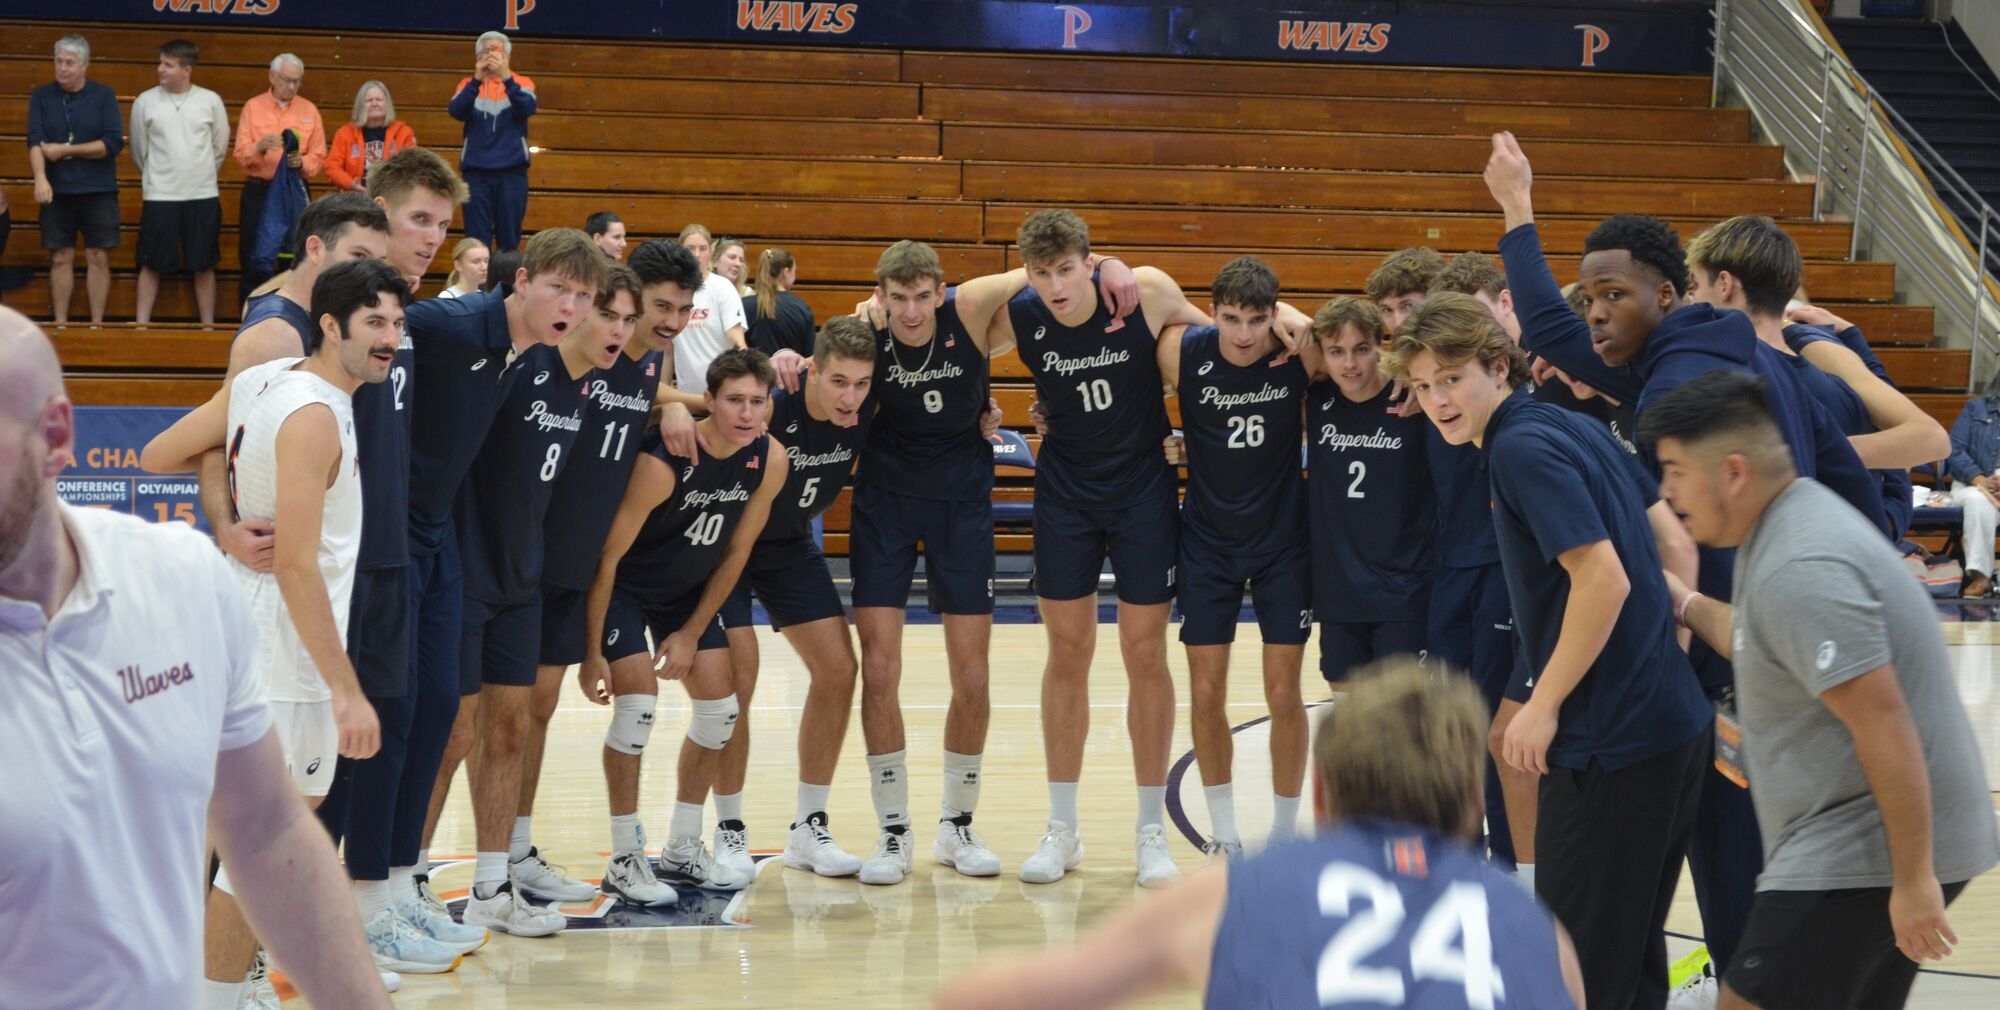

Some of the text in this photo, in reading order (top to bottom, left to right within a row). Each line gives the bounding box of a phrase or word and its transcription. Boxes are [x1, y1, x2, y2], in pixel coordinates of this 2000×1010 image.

[736, 0, 858, 33] WAVES
[1053, 5, 1093, 49] P
[1278, 20, 1391, 52] WAVES
[1573, 24, 1610, 66] P
[1042, 346, 1130, 377] Pepperdine
[589, 379, 650, 412] Pepperdine
[923, 389, 944, 414] 9
[1076, 378, 1113, 412] 10
[1199, 381, 1289, 411] Pepperdine
[599, 421, 630, 461] 11
[1227, 414, 1265, 449] 26
[1318, 423, 1402, 452] Pepperdine
[540, 442, 561, 482] 8
[786, 443, 852, 471] Pepperdine
[57, 481, 127, 493] ONFERENCE
[798, 477, 821, 508] 5
[1347, 460, 1366, 499] 2
[59, 492, 127, 502] AMPIONSHIPS
[153, 502, 197, 529] 15
[683, 511, 725, 546] 40
[116, 661, 195, 704] Waves
[1316, 860, 1507, 1010] 24
